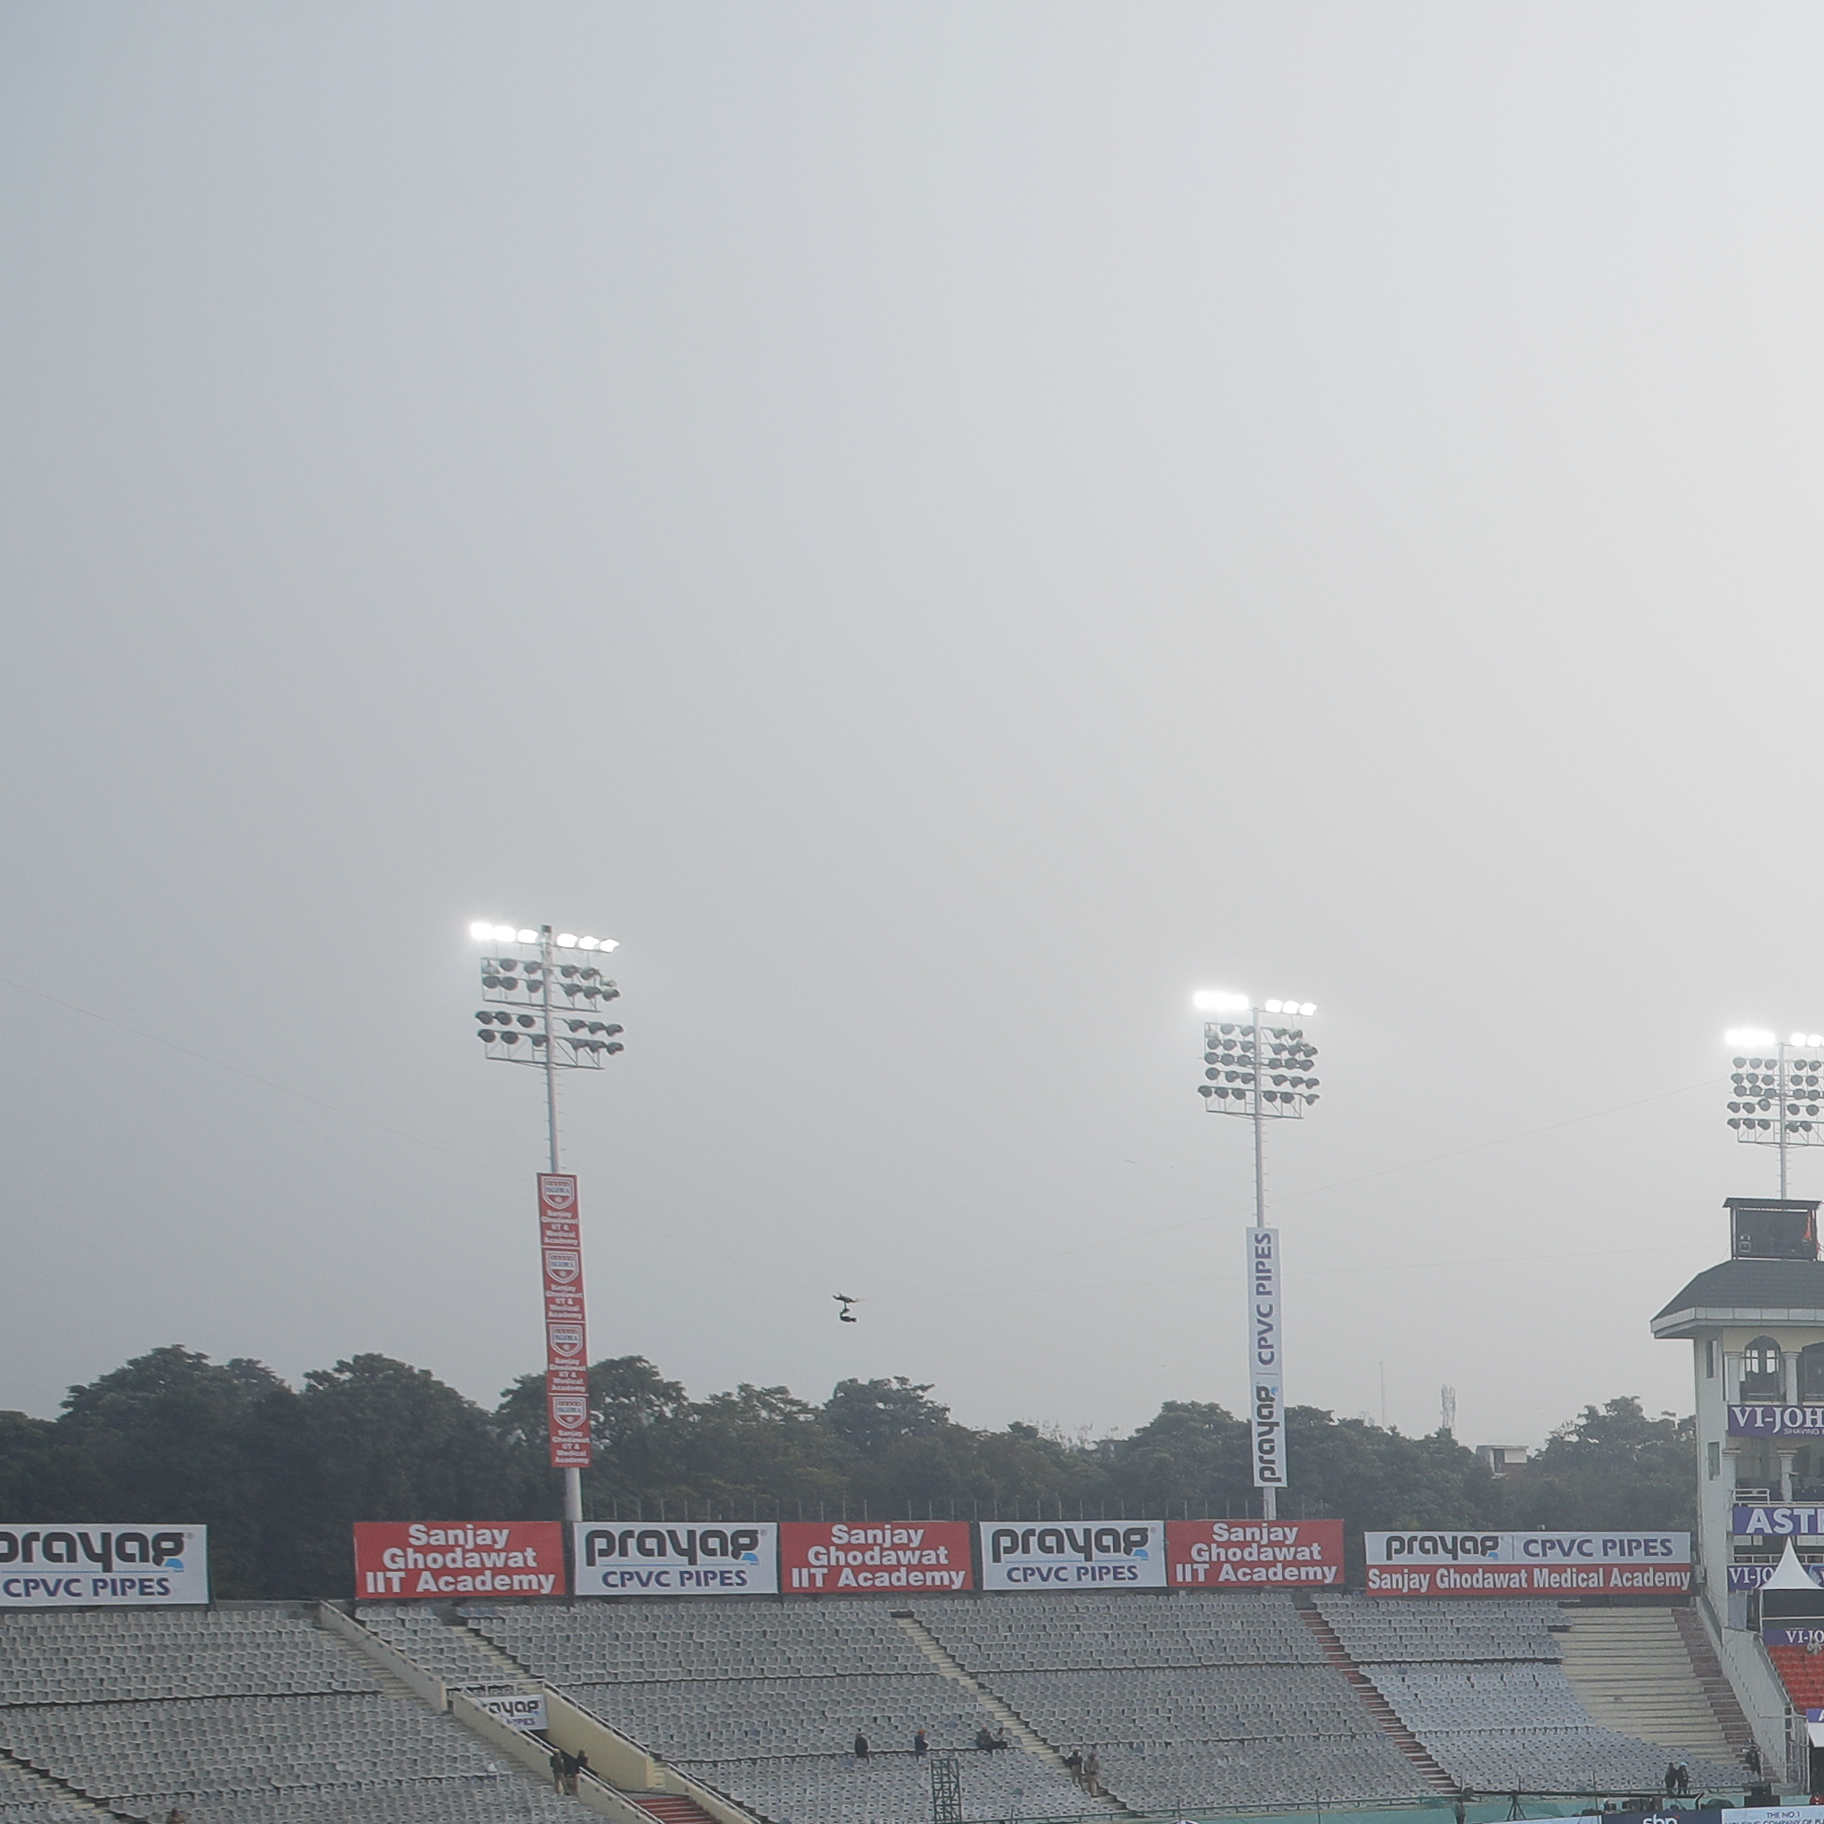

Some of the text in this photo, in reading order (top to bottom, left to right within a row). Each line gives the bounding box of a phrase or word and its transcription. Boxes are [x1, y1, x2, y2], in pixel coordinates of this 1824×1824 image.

[1254, 1233, 1282, 1484] prayag CPVC PIPES
[408, 1524, 510, 1550] Sanjay
[831, 1525, 924, 1548] Sanjay
[992, 1528, 1150, 1562] prayag
[1212, 1523, 1299, 1546] Sanjay
[383, 1547, 537, 1569] Ghodawat
[586, 1528, 760, 1566] prayag
[808, 1546, 949, 1566] Ghodawat
[1191, 1542, 1322, 1562] Ghodawat
[1385, 1535, 1674, 1560] prayag CPVC PIPES
[366, 1570, 557, 1595] IIT Academy
[601, 1569, 747, 1588] CPVC PIPES
[792, 1567, 966, 1590] IIT Academy
[1006, 1565, 1138, 1583] CPVC PIPES
[1175, 1562, 1338, 1583] IIT Academy
[1368, 1567, 1691, 1591] Sanjay Ghodawat Medical Academy
[3, 1577, 170, 1597] CPVC PIPES
